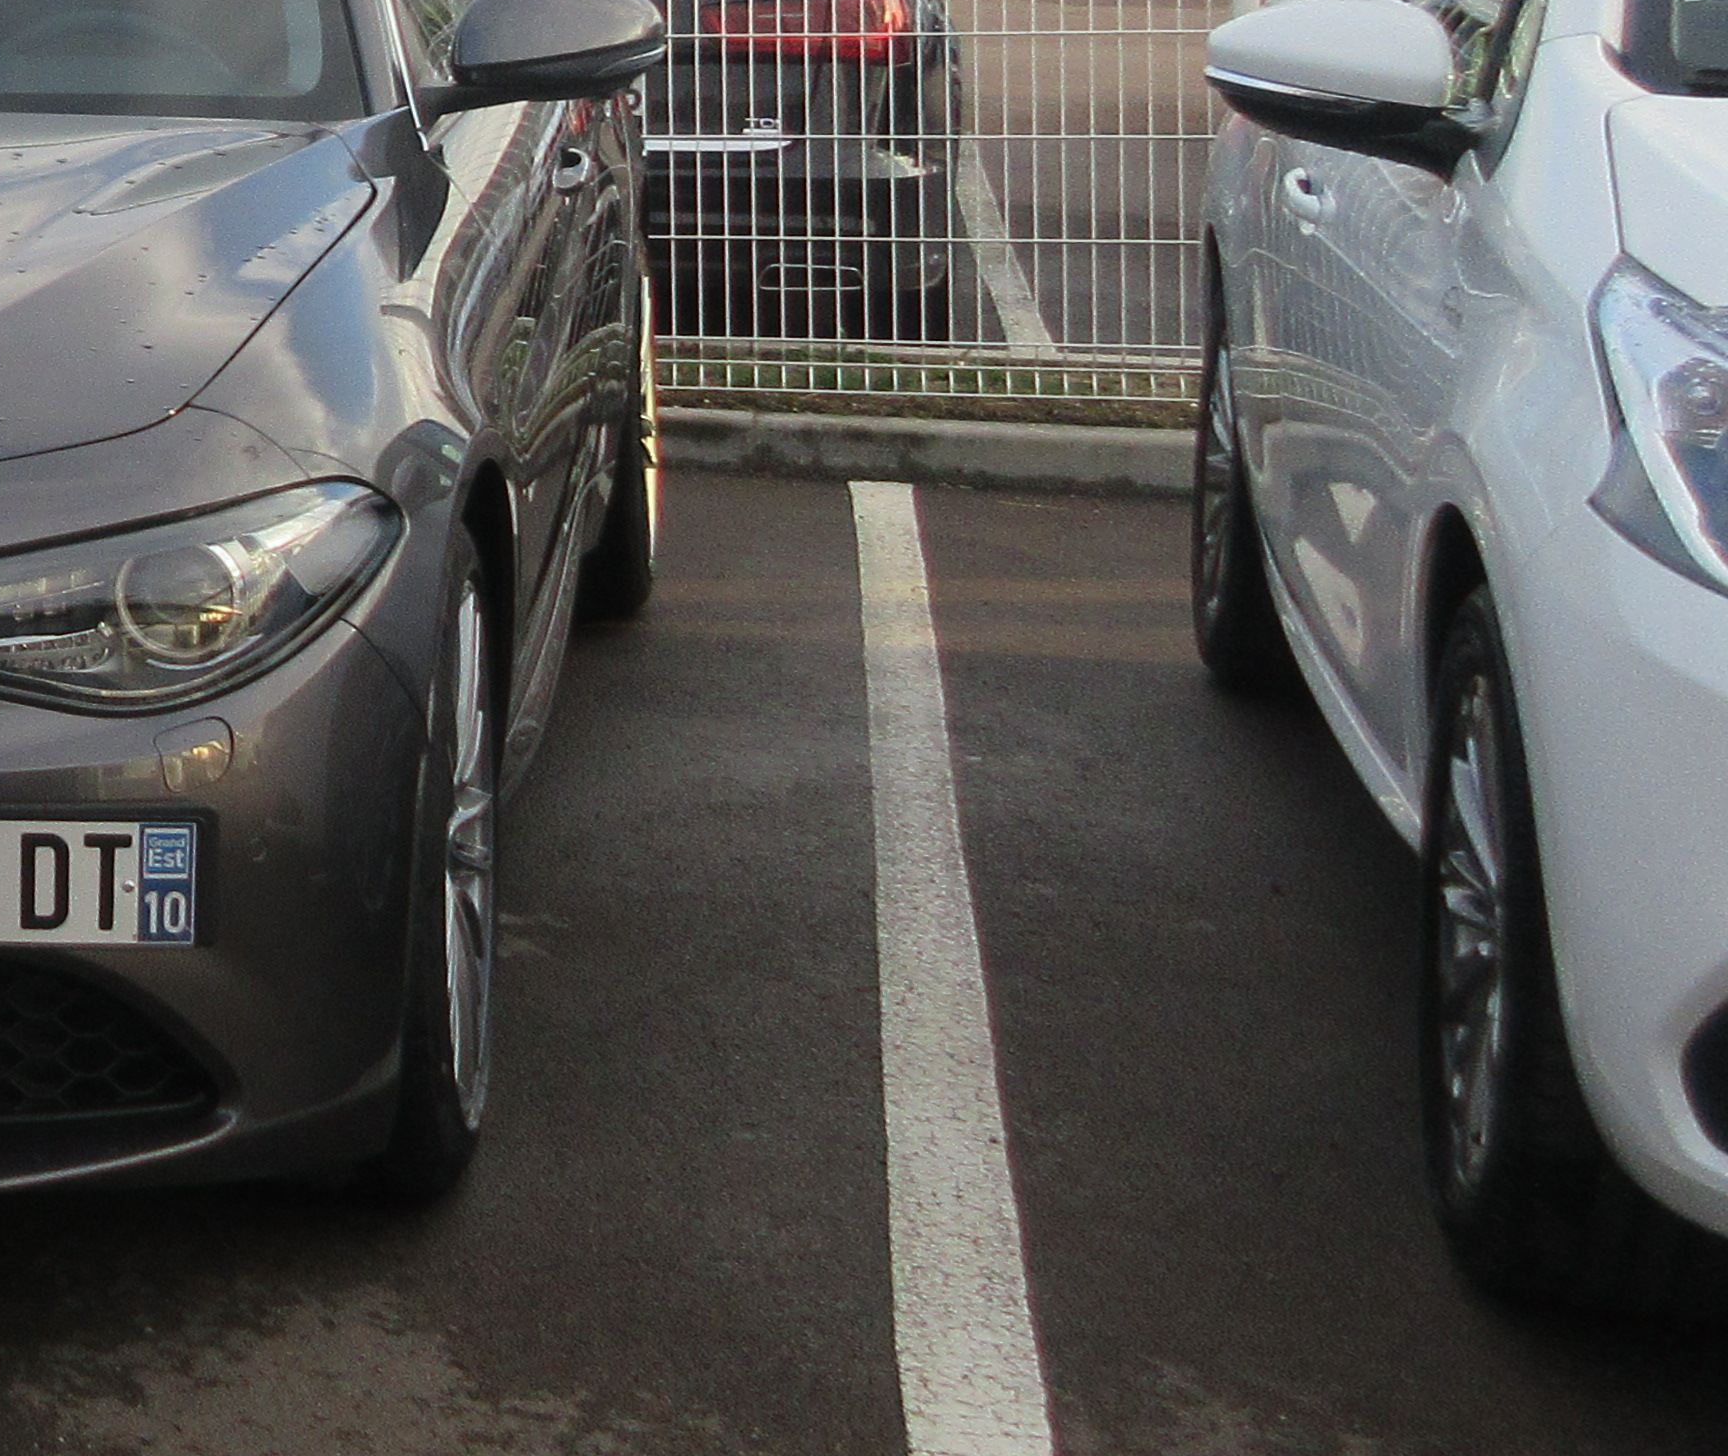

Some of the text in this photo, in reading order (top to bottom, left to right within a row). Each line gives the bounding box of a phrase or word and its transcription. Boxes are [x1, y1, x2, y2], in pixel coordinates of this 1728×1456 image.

[148, 835, 185, 847] Grand
[148, 848, 184, 868] Est
[144, 891, 186, 934] 10
